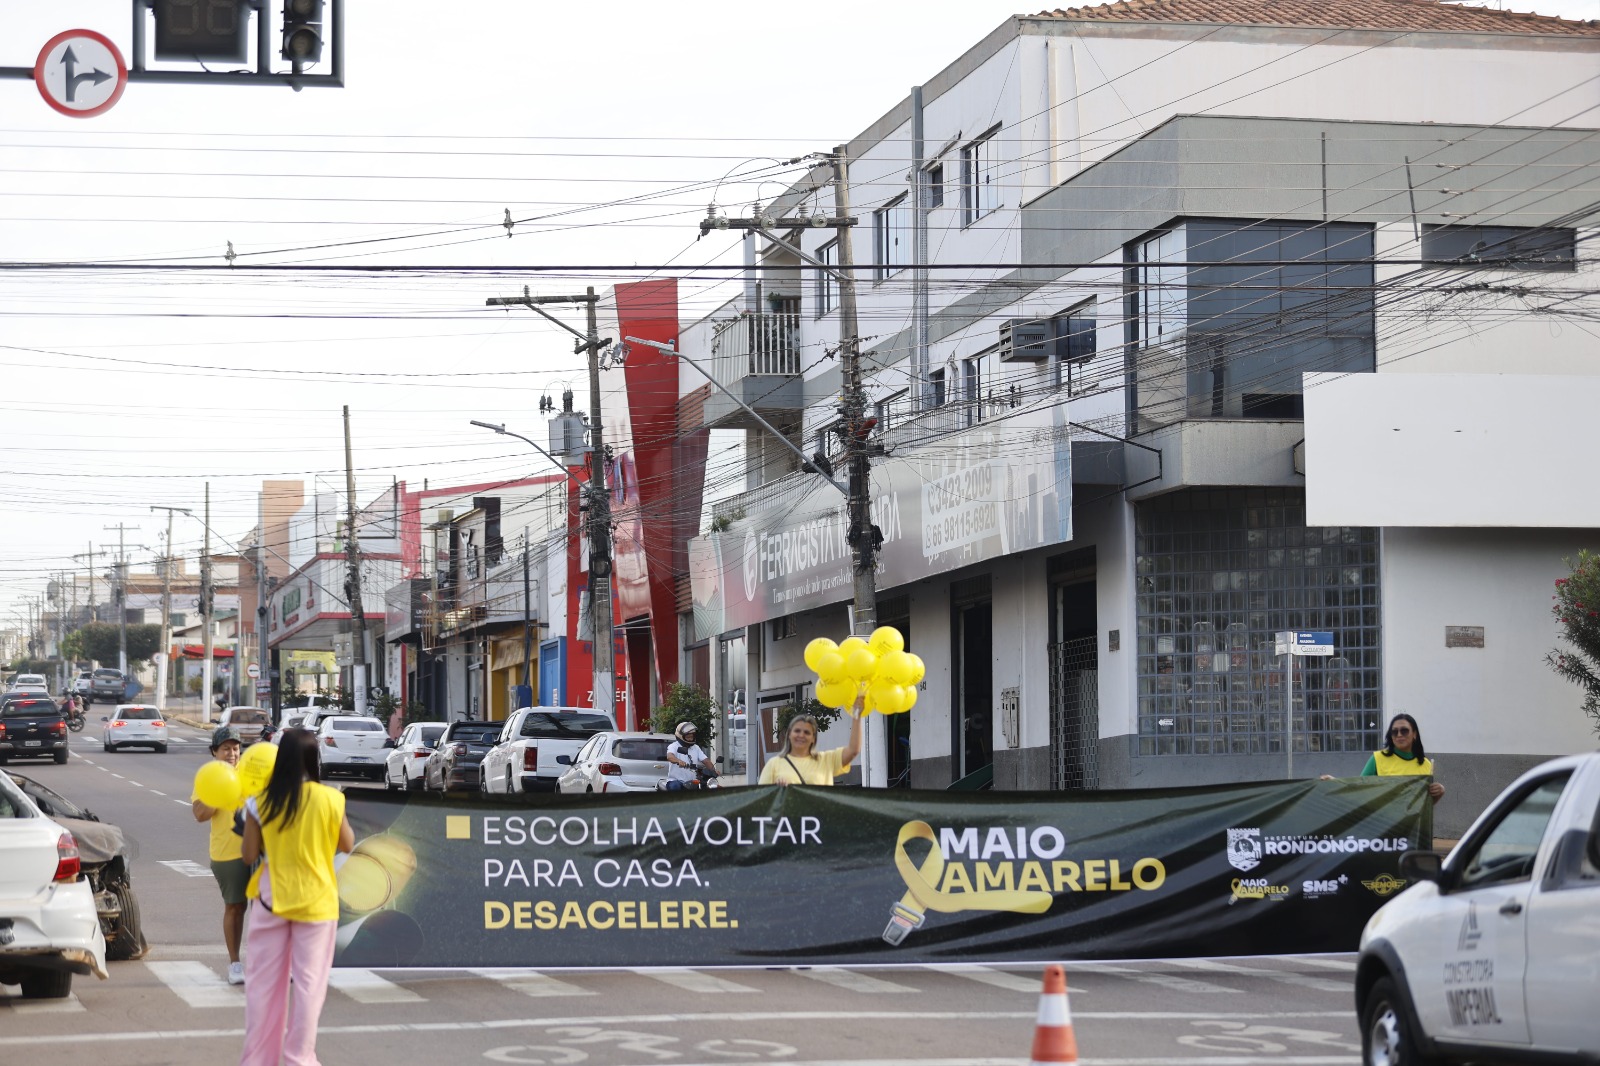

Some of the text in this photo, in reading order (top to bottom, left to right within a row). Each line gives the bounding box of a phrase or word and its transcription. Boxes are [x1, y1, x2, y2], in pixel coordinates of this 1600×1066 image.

[935, 462, 992, 514] 3423-2009
[932, 503, 996, 547] 66 98115-6920
[483, 816, 822, 846] ESCOLHA VOLTAR
[940, 825, 1065, 861] MAIO
[1265, 836, 1408, 855] RONDONÓPOLIS
[484, 859, 711, 888] PARA CASA.
[941, 857, 1166, 894] AMARELO
[1240, 878, 1268, 887] MAIO
[1240, 885, 1290, 895] AMARELO
[484, 901, 739, 930] DESACELERE.
[1443, 959, 1494, 984] CONSTRUTORA
[1446, 986, 1502, 1027] IMPERIAL
